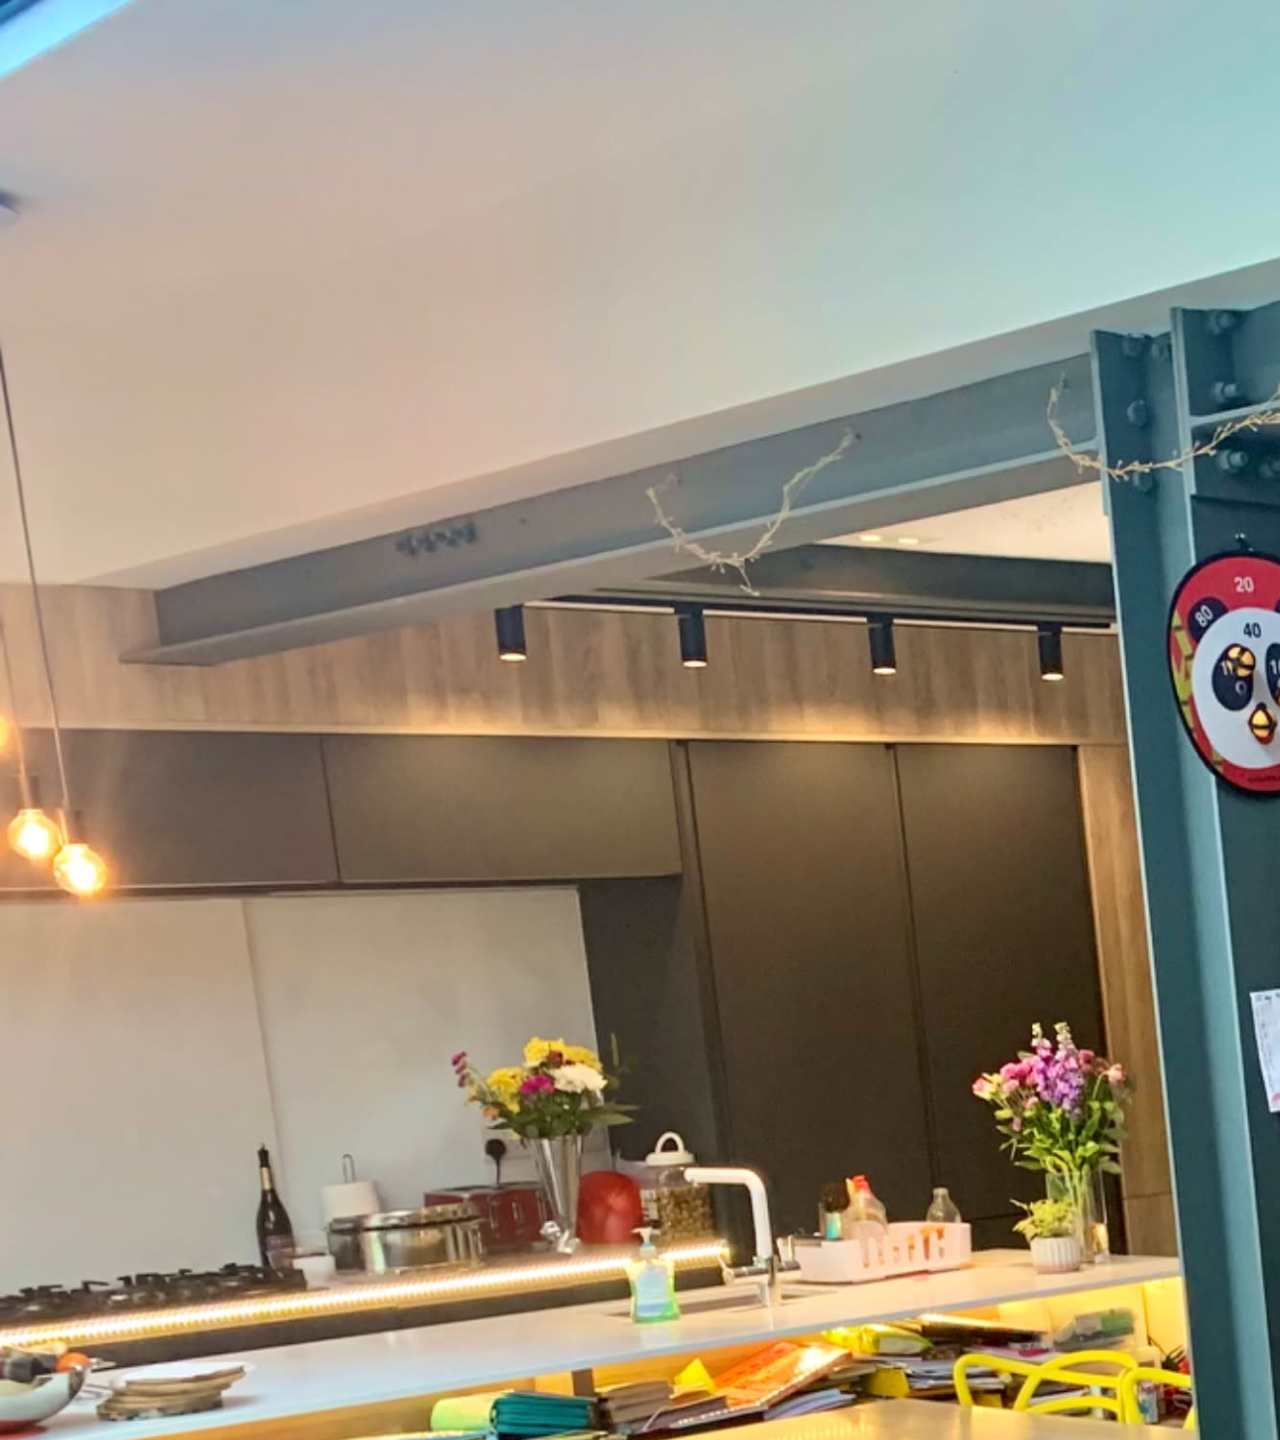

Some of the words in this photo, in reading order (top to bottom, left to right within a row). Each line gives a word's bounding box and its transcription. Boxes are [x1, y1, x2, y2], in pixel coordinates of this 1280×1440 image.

[1233, 576, 1254, 593] 20
[1196, 606, 1213, 627] 80
[1243, 622, 1262, 638] 40
